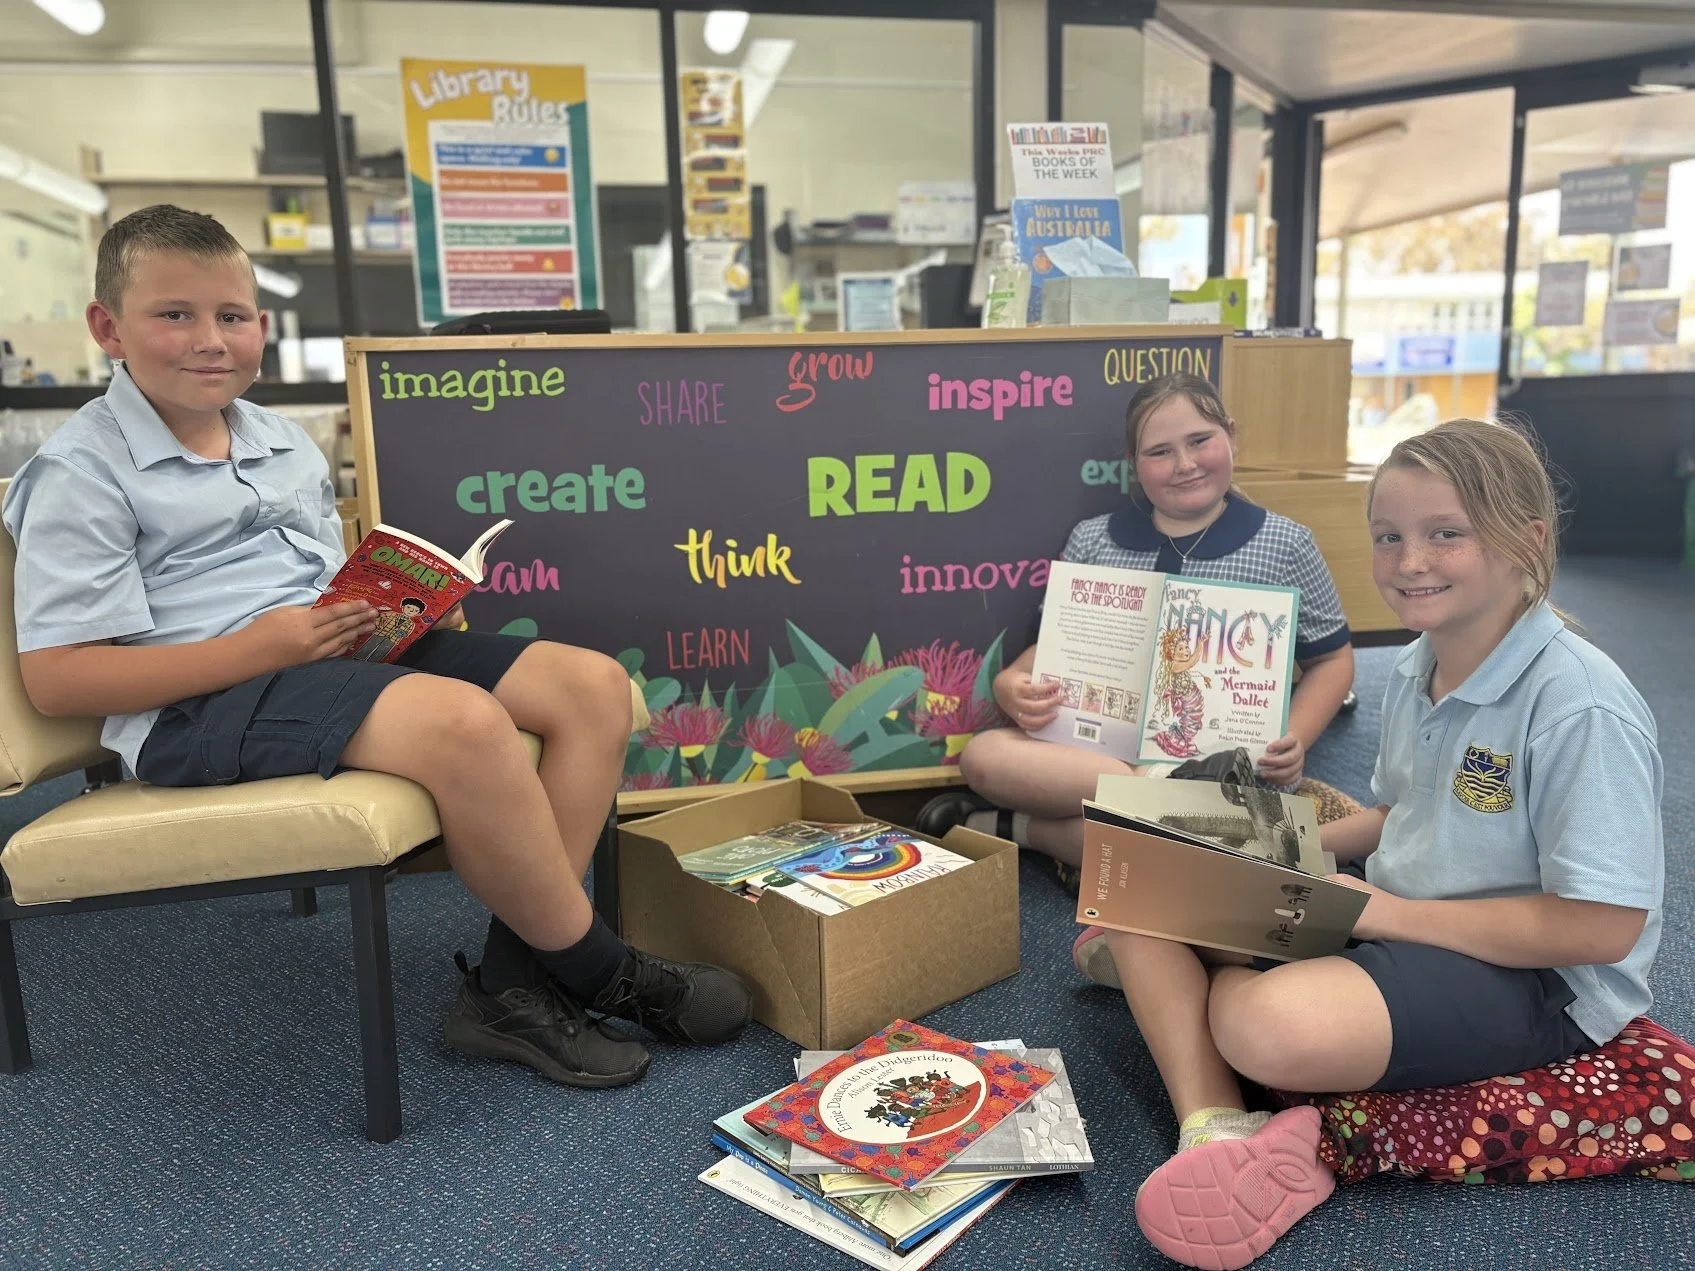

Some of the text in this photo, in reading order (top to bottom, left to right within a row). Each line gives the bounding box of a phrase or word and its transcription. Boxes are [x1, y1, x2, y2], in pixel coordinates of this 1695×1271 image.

[409, 68, 530, 110] Library
[492, 94, 570, 125] Rules
[1020, 148, 1043, 156] This
[1032, 156, 1096, 167] BOOKS OF
[1033, 168, 1098, 179] THE WEEK
[1064, 204, 1070, 218] I
[1104, 347, 1211, 385] QUESTION
[379, 359, 565, 412] imagine
[776, 351, 873, 412] grow
[638, 380, 727, 425] SHARE
[928, 370, 1073, 420] inspire
[456, 464, 646, 514] create
[808, 452, 991, 518] READ
[370, 546, 451, 592] OMAR!
[674, 528, 802, 589] think
[900, 555, 1052, 594] innova
[1071, 578, 1093, 592] FANCY
[1071, 591, 1089, 604] FOR
[1091, 593, 1103, 606] THE
[667, 629, 751, 671] LEARN
[1214, 666, 1240, 675] and the
[1221, 676, 1276, 691] Mermaid
[1233, 692, 1269, 708] Ballet
[1102, 843, 1112, 857] HAT
[872, 864, 952, 893] RAINBOW
[1099, 863, 1111, 886] FOUND
[1097, 888, 1107, 900] WE
[827, 1054, 953, 1133] Ernie Dances to the Didgeridoo
[848, 1068, 895, 1098] Alison Lester
[1017, 1164, 1032, 1172] TAN
[1050, 1163, 1080, 1171] LOTHIAN
[744, 1185, 789, 1211] EVERYTHING
[789, 1206, 803, 1218] gets
[803, 1214, 817, 1224] that
[816, 1220, 832, 1232] book
[832, 1224, 859, 1245] Ahlberg
[858, 1242, 876, 1252] more
